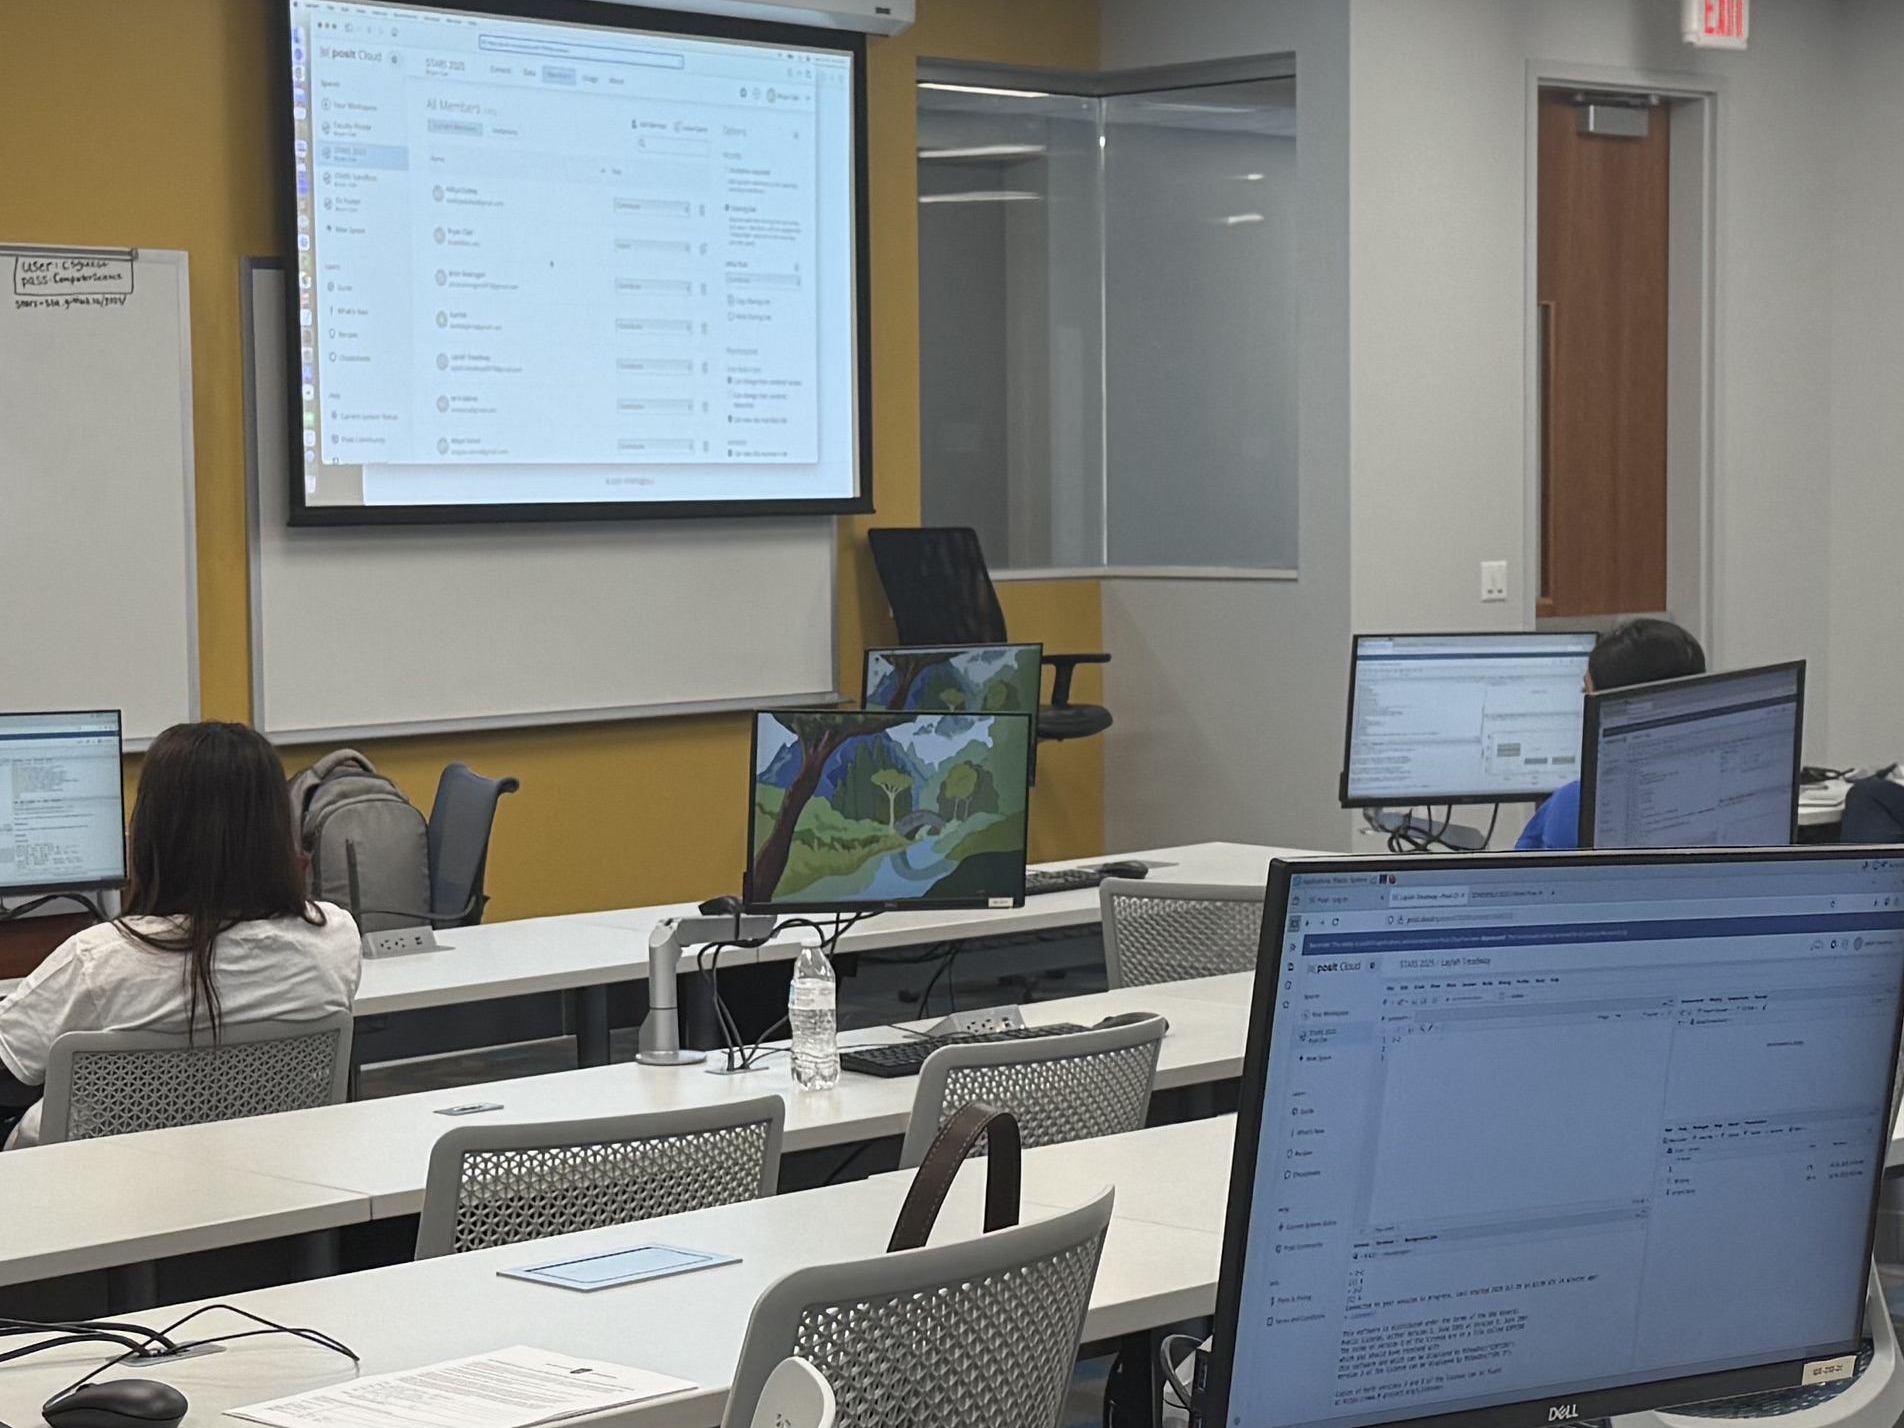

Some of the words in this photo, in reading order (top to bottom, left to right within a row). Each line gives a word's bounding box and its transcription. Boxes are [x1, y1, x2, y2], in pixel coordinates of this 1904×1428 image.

[1317, 963, 1338, 974] posit
[1340, 961, 1360, 971] Cloud
[1548, 1404, 1579, 1422] DELL
